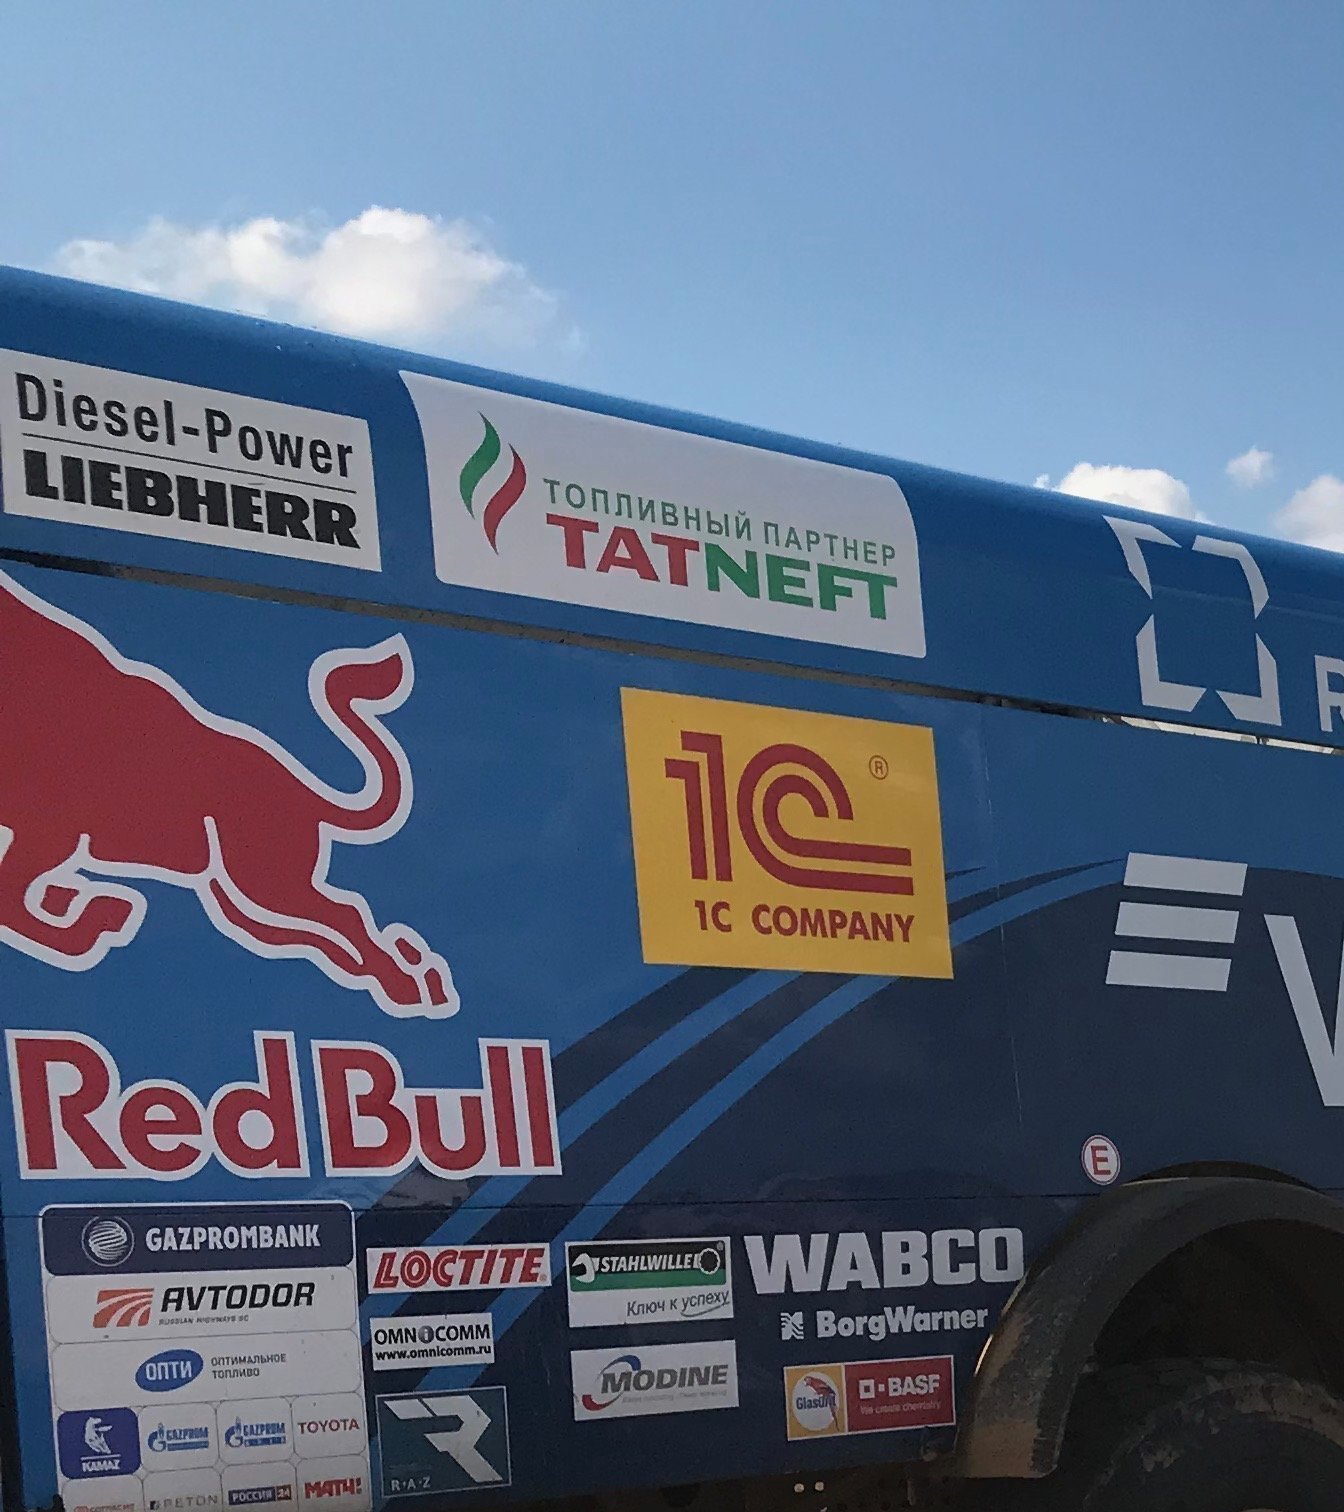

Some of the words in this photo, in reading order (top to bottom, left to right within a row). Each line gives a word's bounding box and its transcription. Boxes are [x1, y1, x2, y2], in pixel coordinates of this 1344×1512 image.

[15, 372, 354, 480] Diesel-Power
[23, 448, 361, 549] LIEBHERR
[543, 477, 753, 543] ТОПЛИВНЫЙ
[763, 520, 898, 567] ПАРТНЕР
[546, 513, 898, 621] TATNEFT
[694, 897, 732, 933] 1C
[751, 906, 914, 944] COMPANY
[5, 1030, 310, 1181] Red
[311, 1037, 562, 1180] Bull
[145, 1223, 321, 1252] GAZPROMBANK
[374, 1248, 545, 1289] LOCTITE
[744, 1227, 1024, 1295] WABCO
[161, 1282, 316, 1313] AVTODOR
[626, 1299, 666, 1317] Ключ
[669, 1298, 678, 1311] к
[680, 1290, 730, 1317] успеху
[816, 1304, 989, 1342] BorgWarner
[211, 1353, 287, 1367] ОПТИМАЛЬНОЕ
[375, 1344, 492, 1362] www.omnicomm.ru
[145, 1360, 193, 1382] ОПТИ
[600, 1363, 729, 1394] MODINE
[888, 1374, 941, 1397] BASF
[297, 1418, 360, 1435] TOYOTA
[232, 1486, 273, 1502] РОССИЯ
